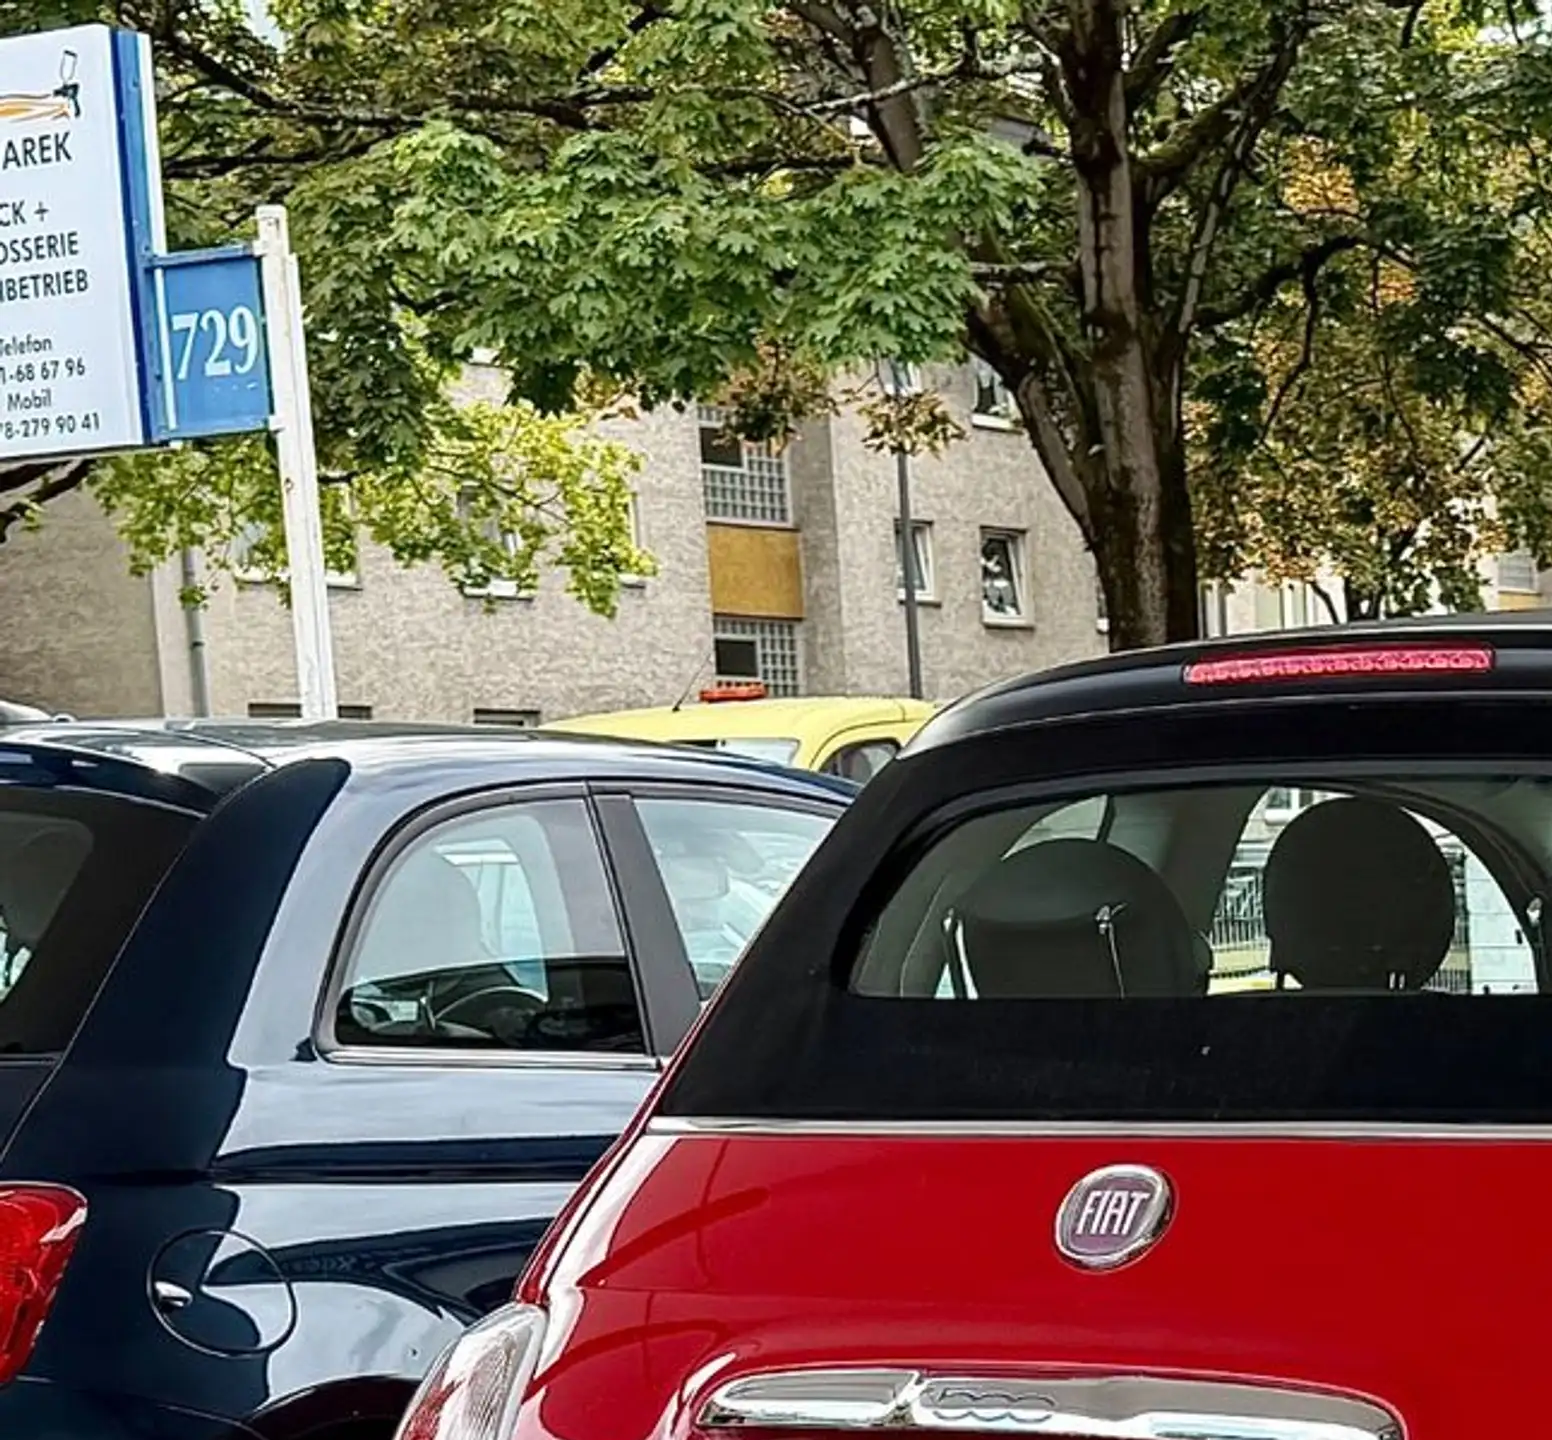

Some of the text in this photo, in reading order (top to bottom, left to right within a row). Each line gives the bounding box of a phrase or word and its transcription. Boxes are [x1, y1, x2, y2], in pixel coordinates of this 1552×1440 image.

[172, 306, 259, 381] 729
[41, 360, 59, 380] 67
[65, 357, 85, 377] 96
[7, 388, 51, 411] Mobil
[56, 415, 76, 434] 90
[81, 412, 99, 431] 41
[1075, 1190, 1151, 1235] FIAT
